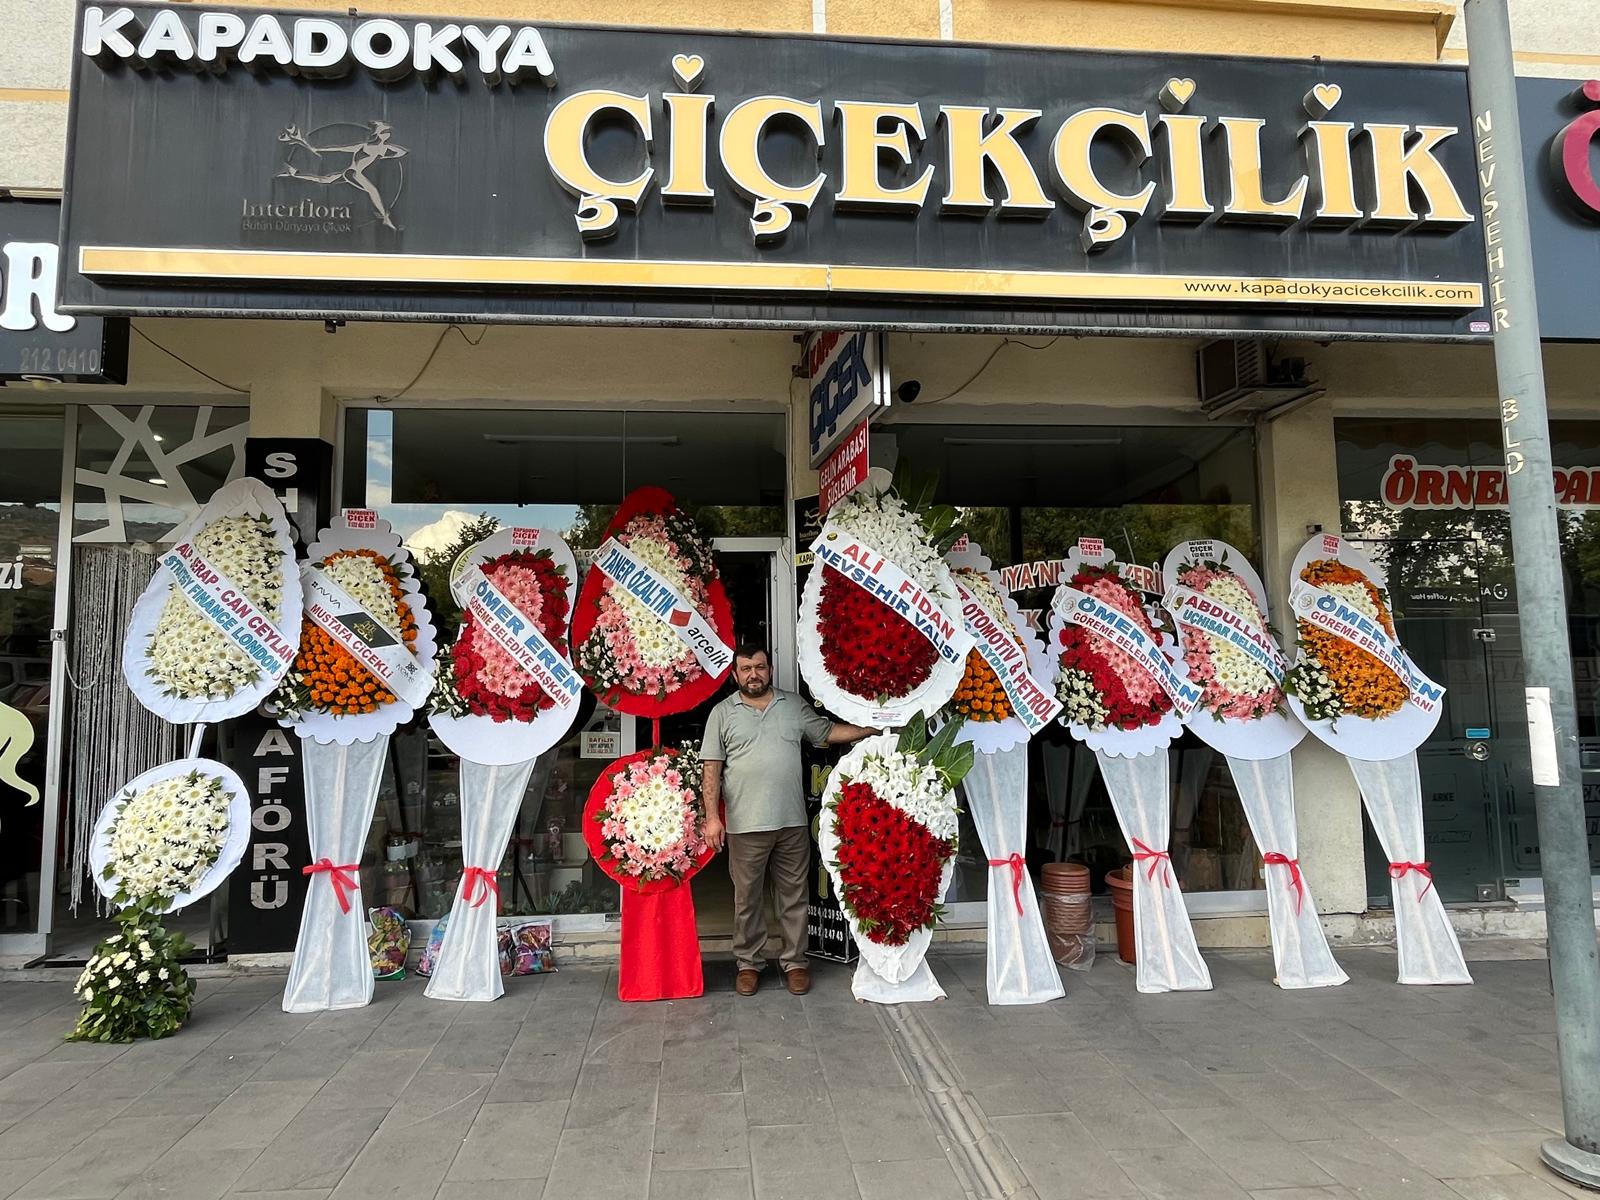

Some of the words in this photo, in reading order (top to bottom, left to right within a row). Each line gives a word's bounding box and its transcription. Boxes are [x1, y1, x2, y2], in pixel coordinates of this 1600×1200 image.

[82, 7, 554, 76] KAPADOKYA
[544, 54, 1475, 247] ÇİÇEKÇİLİK
[242, 198, 352, 218] Interflora
[1184, 281, 1473, 299] www.kapadokyacicekcilik.com
[837, 428, 866, 474] ARABASI
[1501, 398, 1525, 476] BLD
[1385, 458, 1509, 505] ÖRNE
[601, 548, 636, 585] TANER
[187, 584, 238, 632] FINANCE
[231, 626, 282, 675] LONDON
[221, 590, 252, 620] CAN
[247, 616, 296, 663] CEYLAN
[310, 603, 353, 642] MUSTAFA
[476, 580, 526, 637] ÖMER
[524, 634, 582, 696] EREN
[491, 621, 534, 664] BELEDİYE
[1185, 595, 1272, 654] ABDULLAH
[1316, 594, 1387, 648] ÖMER
[687, 627, 729, 669] arçelik
[977, 643, 1009, 682] AYDIN
[1009, 661, 1023, 677] &
[1077, 596, 1146, 648] ÖMER
[1148, 646, 1200, 703] EREN
[1013, 671, 1056, 722] PETROL
